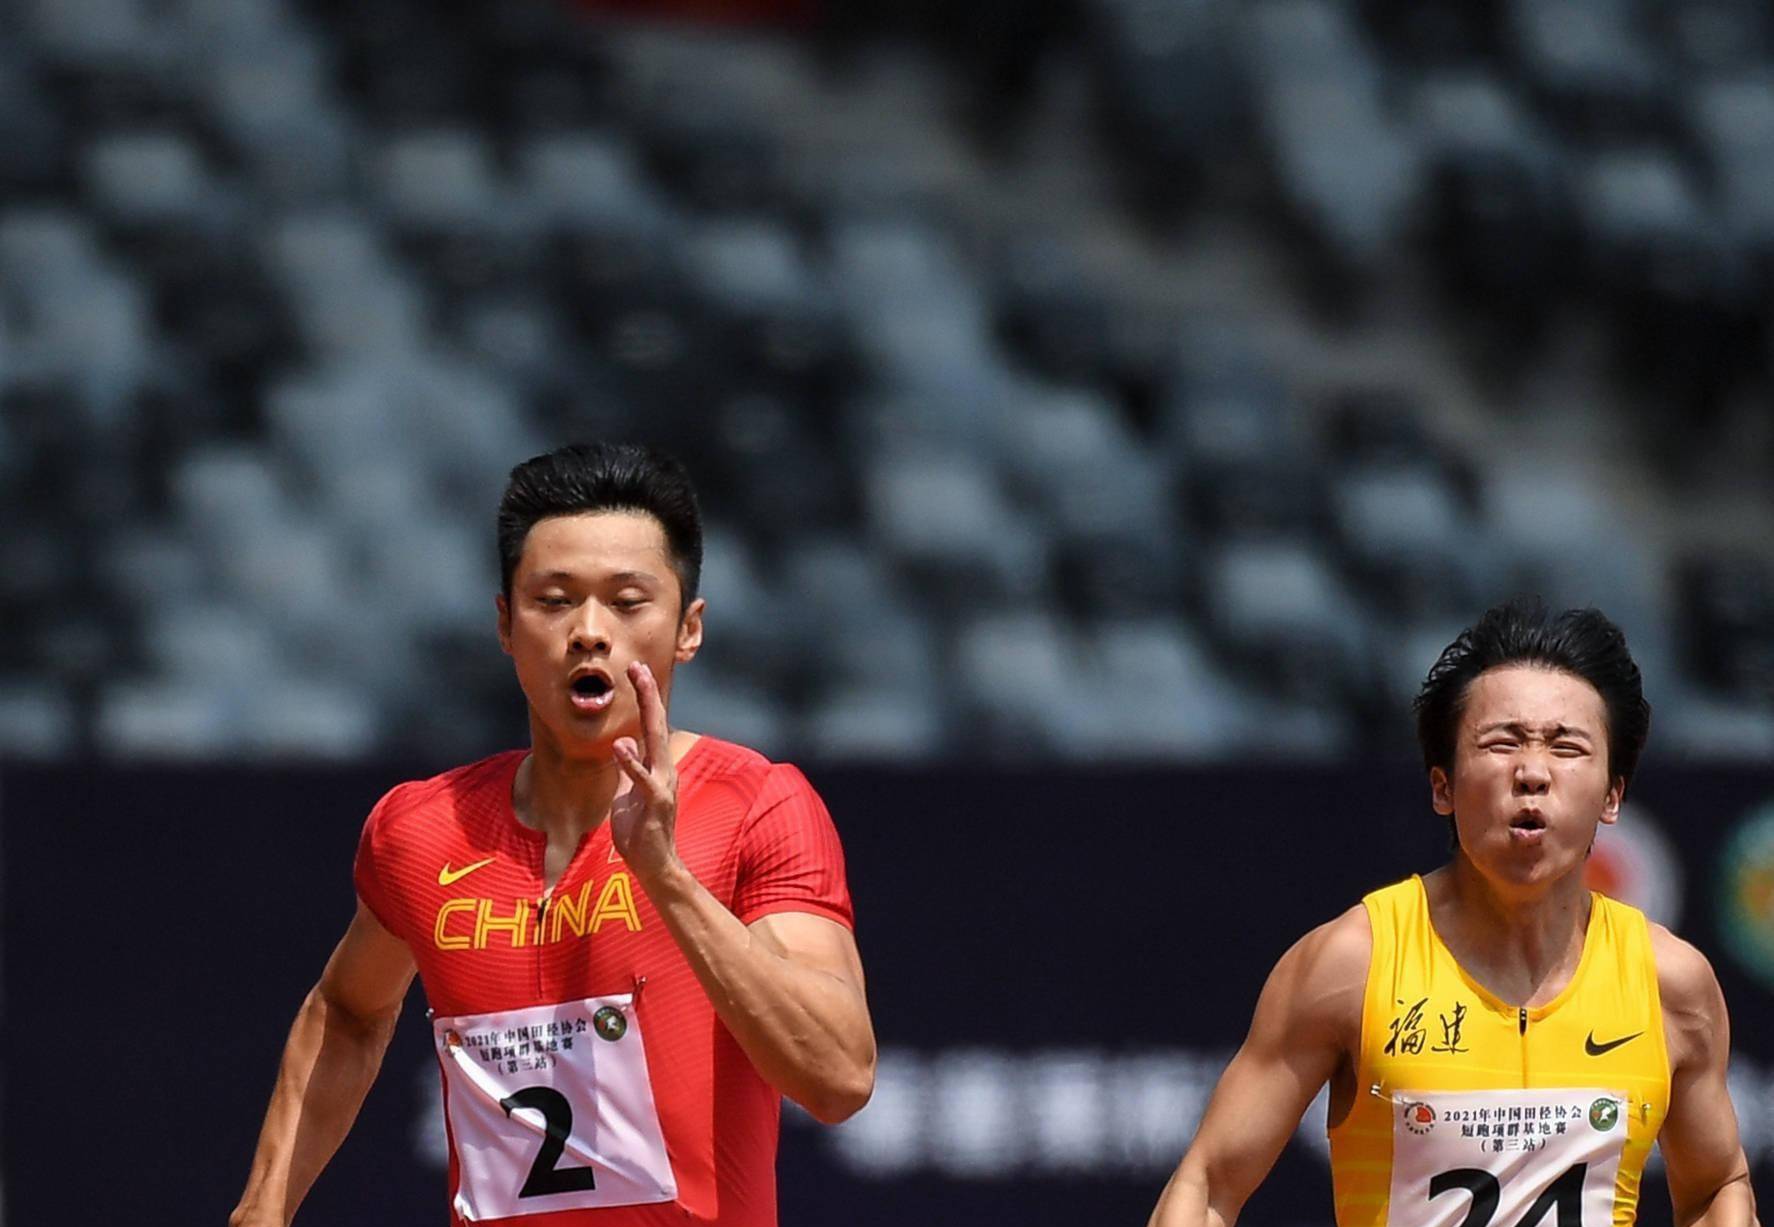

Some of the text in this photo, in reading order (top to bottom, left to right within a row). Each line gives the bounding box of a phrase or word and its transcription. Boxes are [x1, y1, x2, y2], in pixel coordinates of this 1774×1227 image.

[434, 871, 642, 950] CHINA
[500, 1086, 595, 1198] 2
[1444, 1105, 1582, 1122] 2021年中国田径协会
